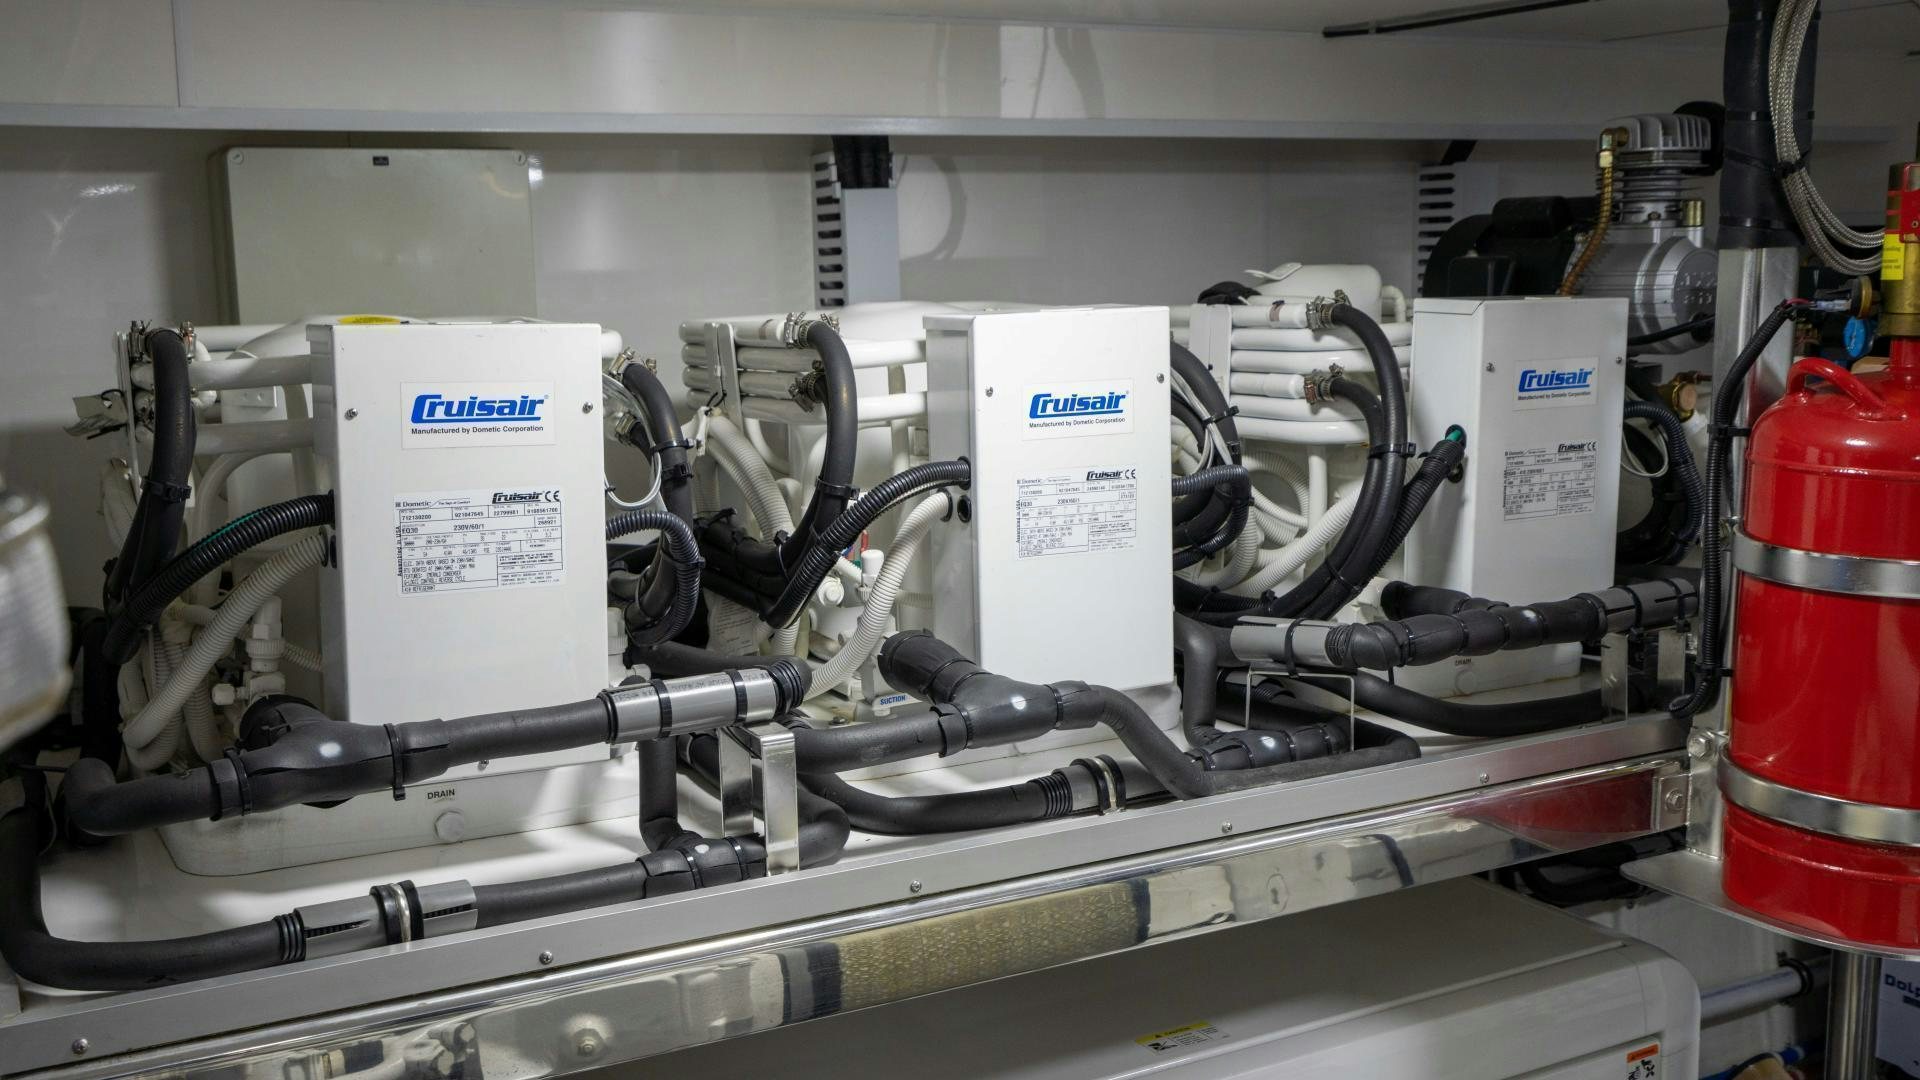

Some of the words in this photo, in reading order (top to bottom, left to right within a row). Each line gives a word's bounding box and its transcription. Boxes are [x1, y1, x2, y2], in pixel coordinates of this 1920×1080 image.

[1518, 368, 1592, 392] Cruisair
[411, 394, 545, 424] Cruisair
[1029, 392, 1126, 418] Cruisair
[411, 427, 460, 435] Manufactured
[461, 427, 471, 435] by
[502, 425, 544, 433] Corporation
[1086, 470, 1123, 481] Cruisair
[492, 492, 542, 504] Cruisair
[880, 694, 907, 705] SUCTION
[427, 789, 455, 800] DRAIN
